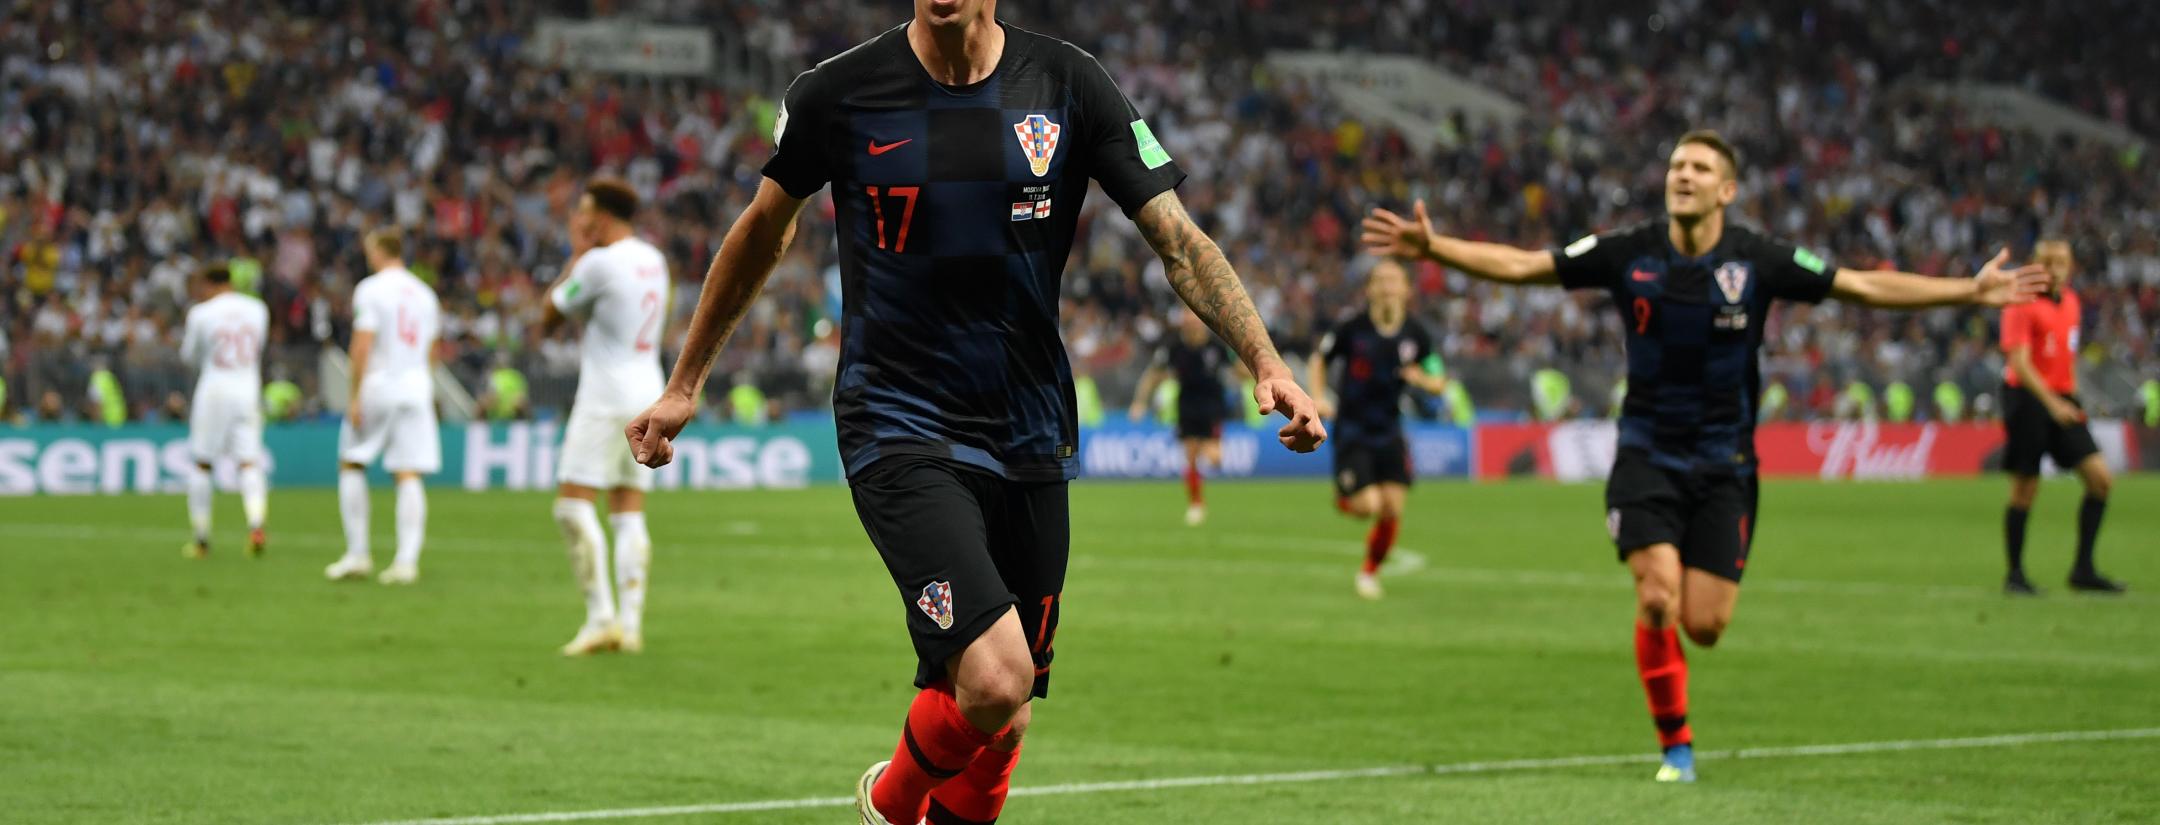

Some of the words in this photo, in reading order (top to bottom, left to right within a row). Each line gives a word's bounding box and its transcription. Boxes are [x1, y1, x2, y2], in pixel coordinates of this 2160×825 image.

[866, 186, 920, 253] 17
[636, 290, 660, 352] 2
[1632, 297, 1651, 335] 9
[463, 423, 812, 488] Hinse
[1085, 433, 1259, 475] MOSW
